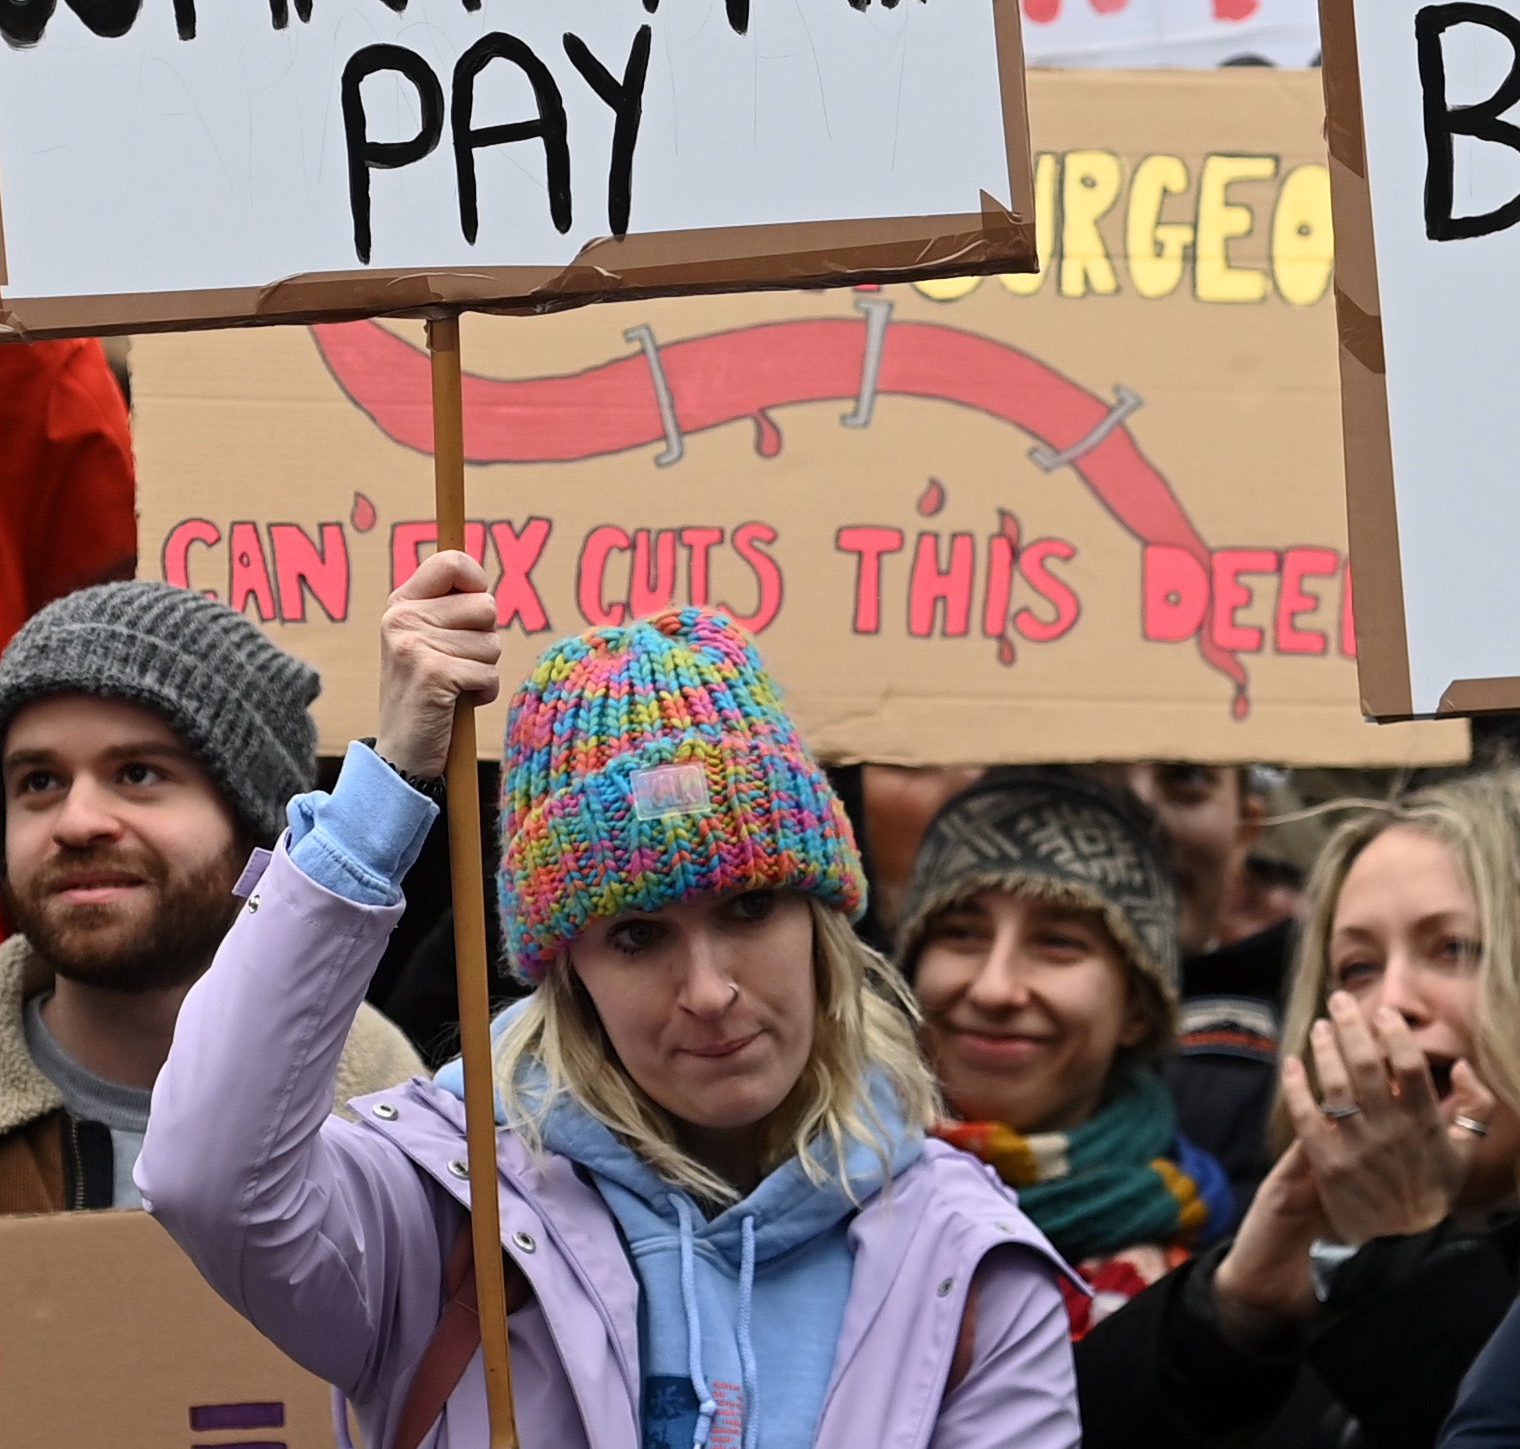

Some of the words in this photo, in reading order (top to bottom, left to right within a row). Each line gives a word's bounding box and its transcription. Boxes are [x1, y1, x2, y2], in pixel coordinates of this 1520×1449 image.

[341, 23, 653, 266] PAY
[578, 521, 784, 635] CUTS
[835, 525, 1082, 642] THIS
